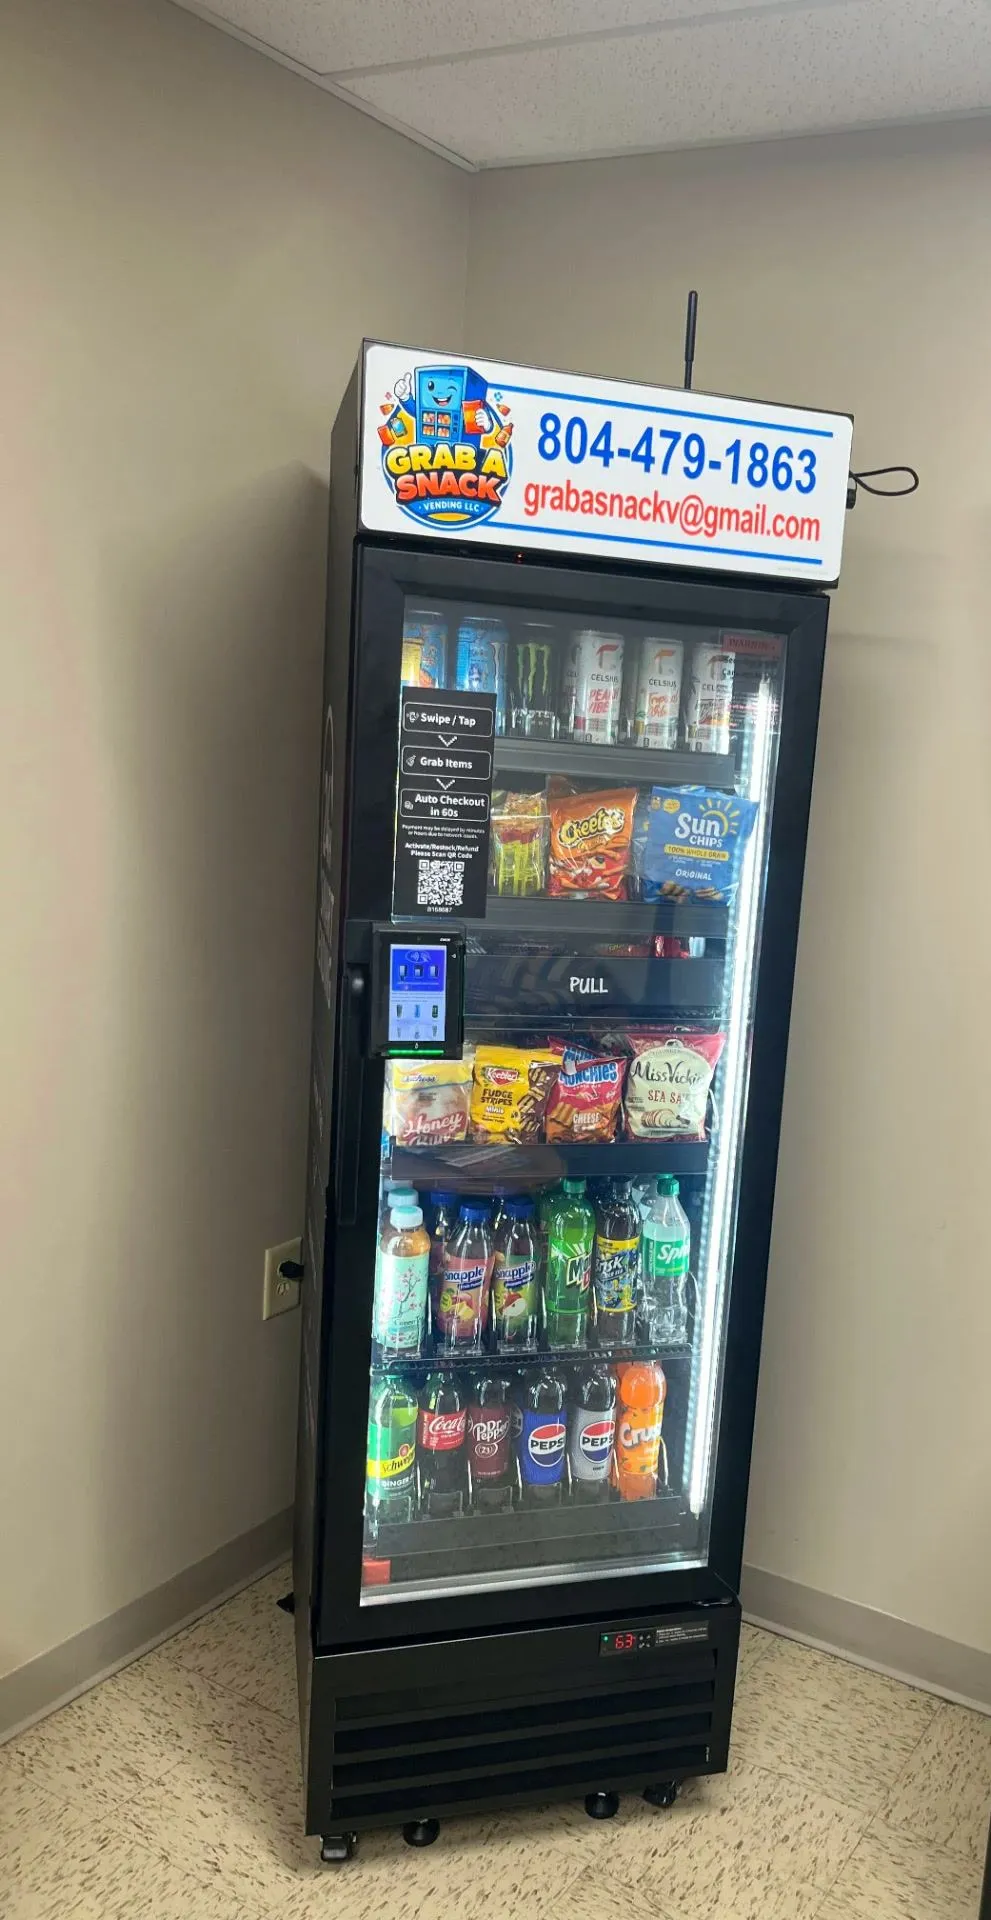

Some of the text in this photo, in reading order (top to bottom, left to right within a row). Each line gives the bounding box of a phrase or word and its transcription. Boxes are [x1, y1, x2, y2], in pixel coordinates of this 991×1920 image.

[538, 412, 817, 495] 804-479-1863
[386, 444, 507, 478] GRAB A
[396, 471, 501, 502] SNACK
[423, 501, 480, 512] VENDING LLC
[524, 479, 820, 542] grabasnackv@gmail.com
[648, 678, 677, 688] CELSIUS
[420, 712, 450, 726] Swipe
[458, 715, 476, 727] Tap
[420, 757, 473, 770] Grab Items
[415, 793, 485, 807] Auto Checkout
[430, 807, 458, 818] in 60s
[674, 812, 720, 839] Sun
[689, 835, 723, 848] CHIPS
[410, 849, 431, 857] Please
[431, 850, 446, 858] Scan
[447, 851, 457, 859] QR
[569, 976, 608, 995] PULL
[630, 1060, 704, 1088] Miss Vicki
[482, 1088, 513, 1099] FUDGE
[647, 1089, 666, 1103] SEA
[480, 1096, 513, 1106] STRIPES
[573, 1112, 601, 1124] CHEESE
[402, 1113, 463, 1138] Honey
[486, 1420, 502, 1431] Dr
[530, 1439, 564, 1450] PEPS
[582, 1434, 613, 1447] PEPS
[615, 1634, 633, 1649] 63
